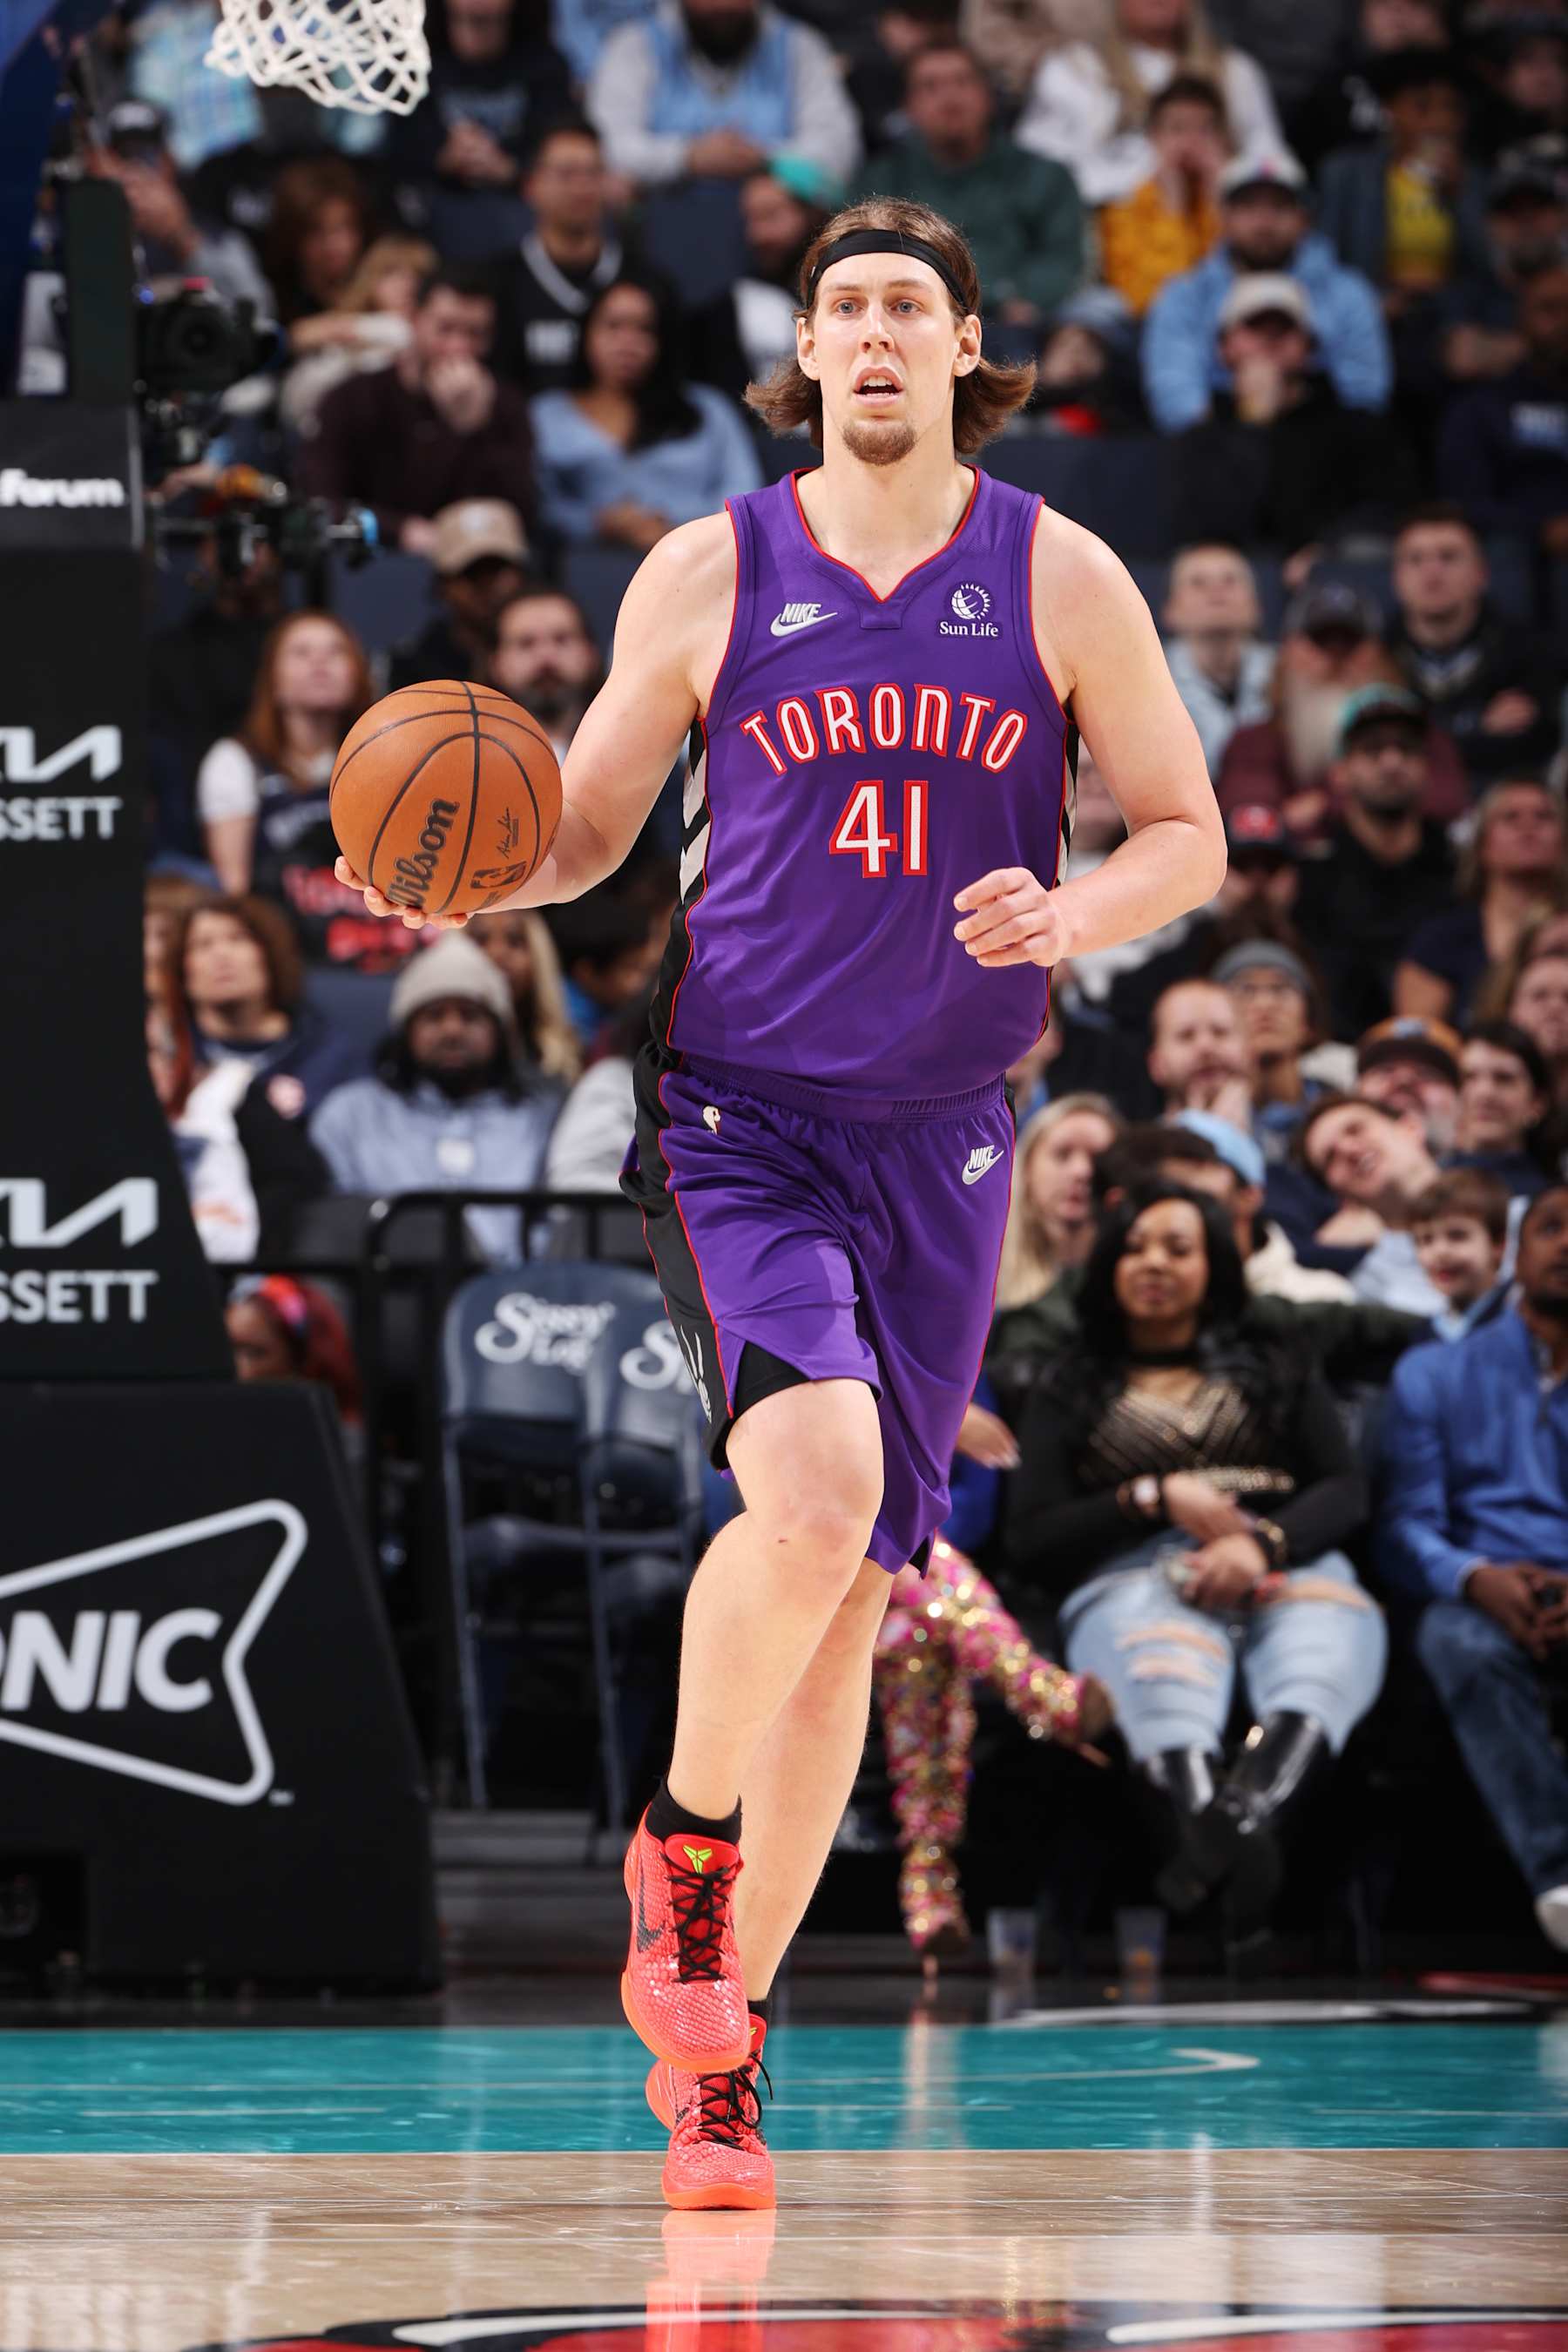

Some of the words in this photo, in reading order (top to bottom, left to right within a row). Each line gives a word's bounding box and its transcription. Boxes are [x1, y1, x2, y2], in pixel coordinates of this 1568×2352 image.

[781, 603, 821, 623] NIKE
[940, 621, 969, 635] Sun
[971, 622, 999, 637] Life
[740, 683, 1029, 775] TORONTO
[0, 796, 123, 841] SETT
[829, 780, 929, 878] 41
[0, 1608, 222, 1713] NIC
